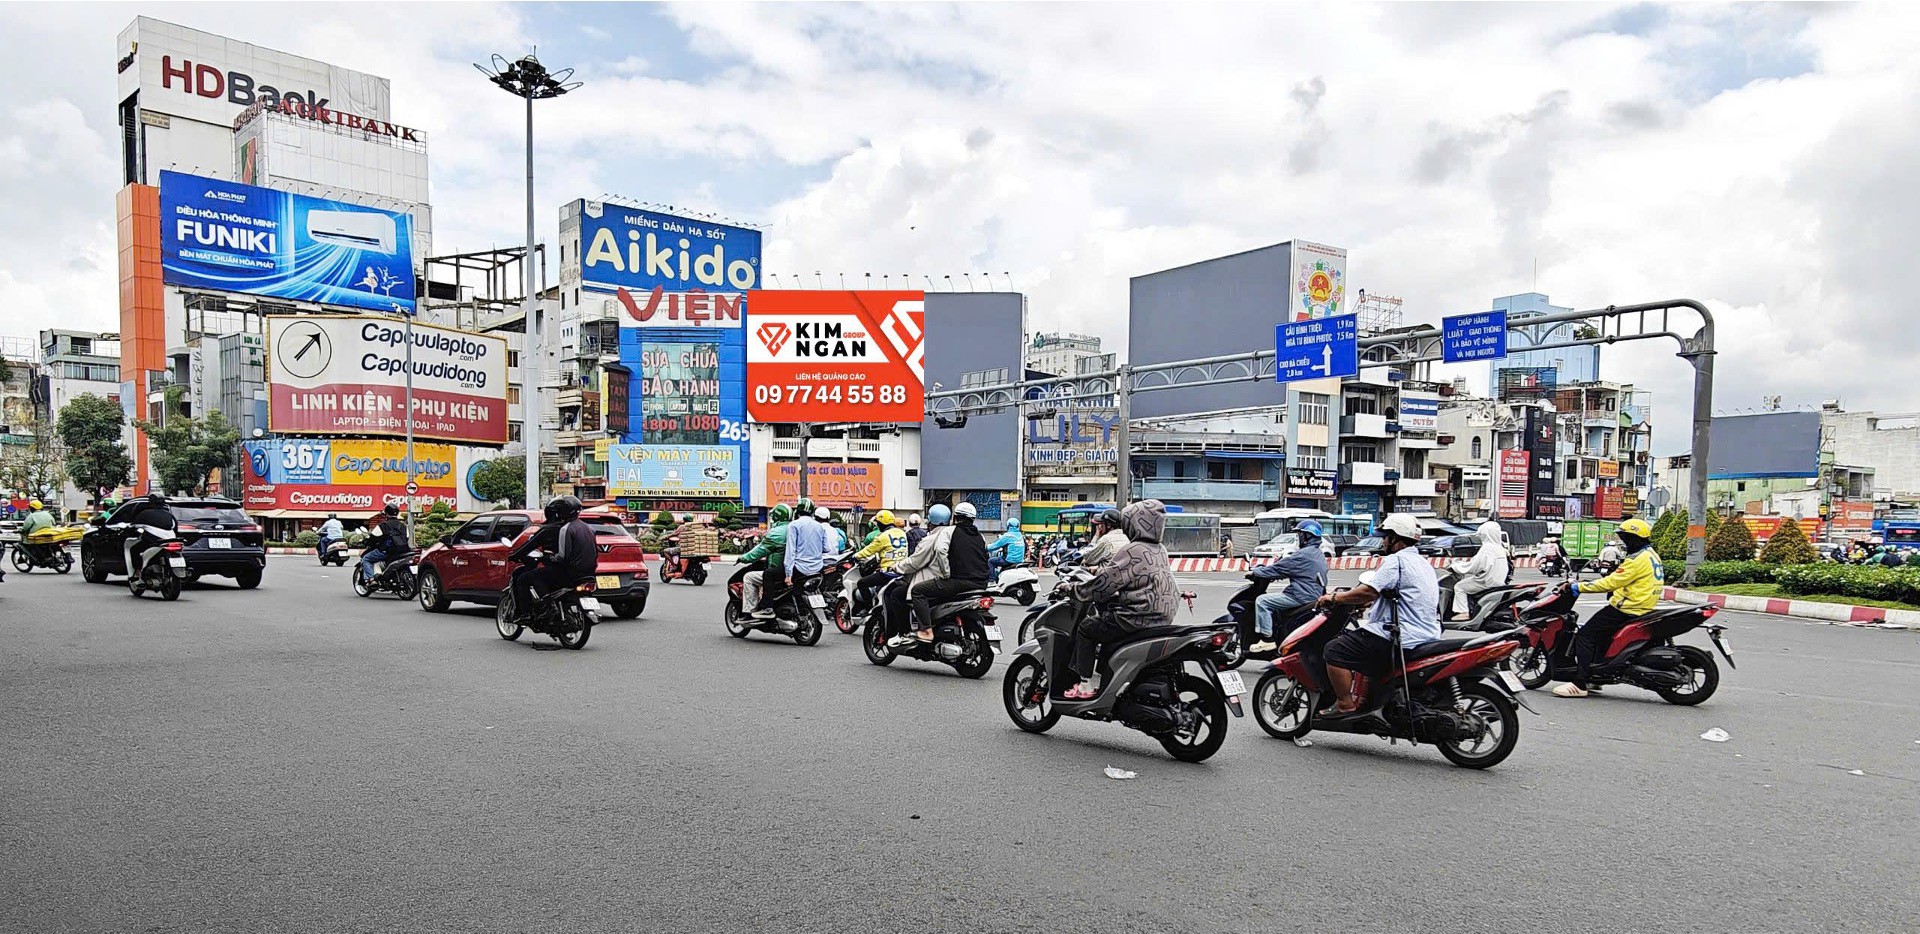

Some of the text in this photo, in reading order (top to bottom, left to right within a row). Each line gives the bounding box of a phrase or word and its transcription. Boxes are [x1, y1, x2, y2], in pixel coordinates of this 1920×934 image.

[162, 55, 330, 120] HDBank
[275, 98, 419, 142] AGRIBANK
[220, 212, 252, 225] THÔNG
[624, 214, 727, 241] MIẾNG DÁN HẠ SỐT
[177, 219, 276, 254] FUNIKI
[585, 227, 756, 290] Aikido
[617, 284, 742, 326] VIỆN
[361, 323, 487, 360] Capcuulaptop
[796, 322, 866, 339] KIM GROUP
[642, 345, 718, 369] SỬA CHỮA
[796, 341, 866, 357] NGAN
[361, 353, 487, 388] Capcuudidong
[795, 371, 866, 382] LIÊN HỆ QUẢNG CÁO
[642, 369, 674, 396] BẢO
[679, 375, 720, 396] HÀNH
[755, 385, 906, 404] 09 77 44 55 88
[291, 393, 336, 411] LINH
[342, 391, 392, 414] KIỆN
[412, 400, 446, 418] PHỤ
[450, 400, 489, 423] KIỆN
[333, 416, 369, 427] LAPTOP
[378, 416, 402, 429] ĐIỆN
[436, 423, 456, 432] IPAD
[684, 414, 720, 431] 1080
[719, 419, 750, 442] 265
[1029, 414, 1120, 443] LILY
[282, 444, 329, 469] 367
[656, 446, 693, 462] MÁY
[696, 446, 733, 462] TÍNH
[1030, 445, 1054, 462] KÍNH
[1085, 445, 1101, 462] GIÁ
[290, 491, 372, 507] Capcuudidong
[818, 478, 877, 498] HOÀNG
[653, 501, 694, 511] LAPTOP
[888, 533, 907, 549] be
